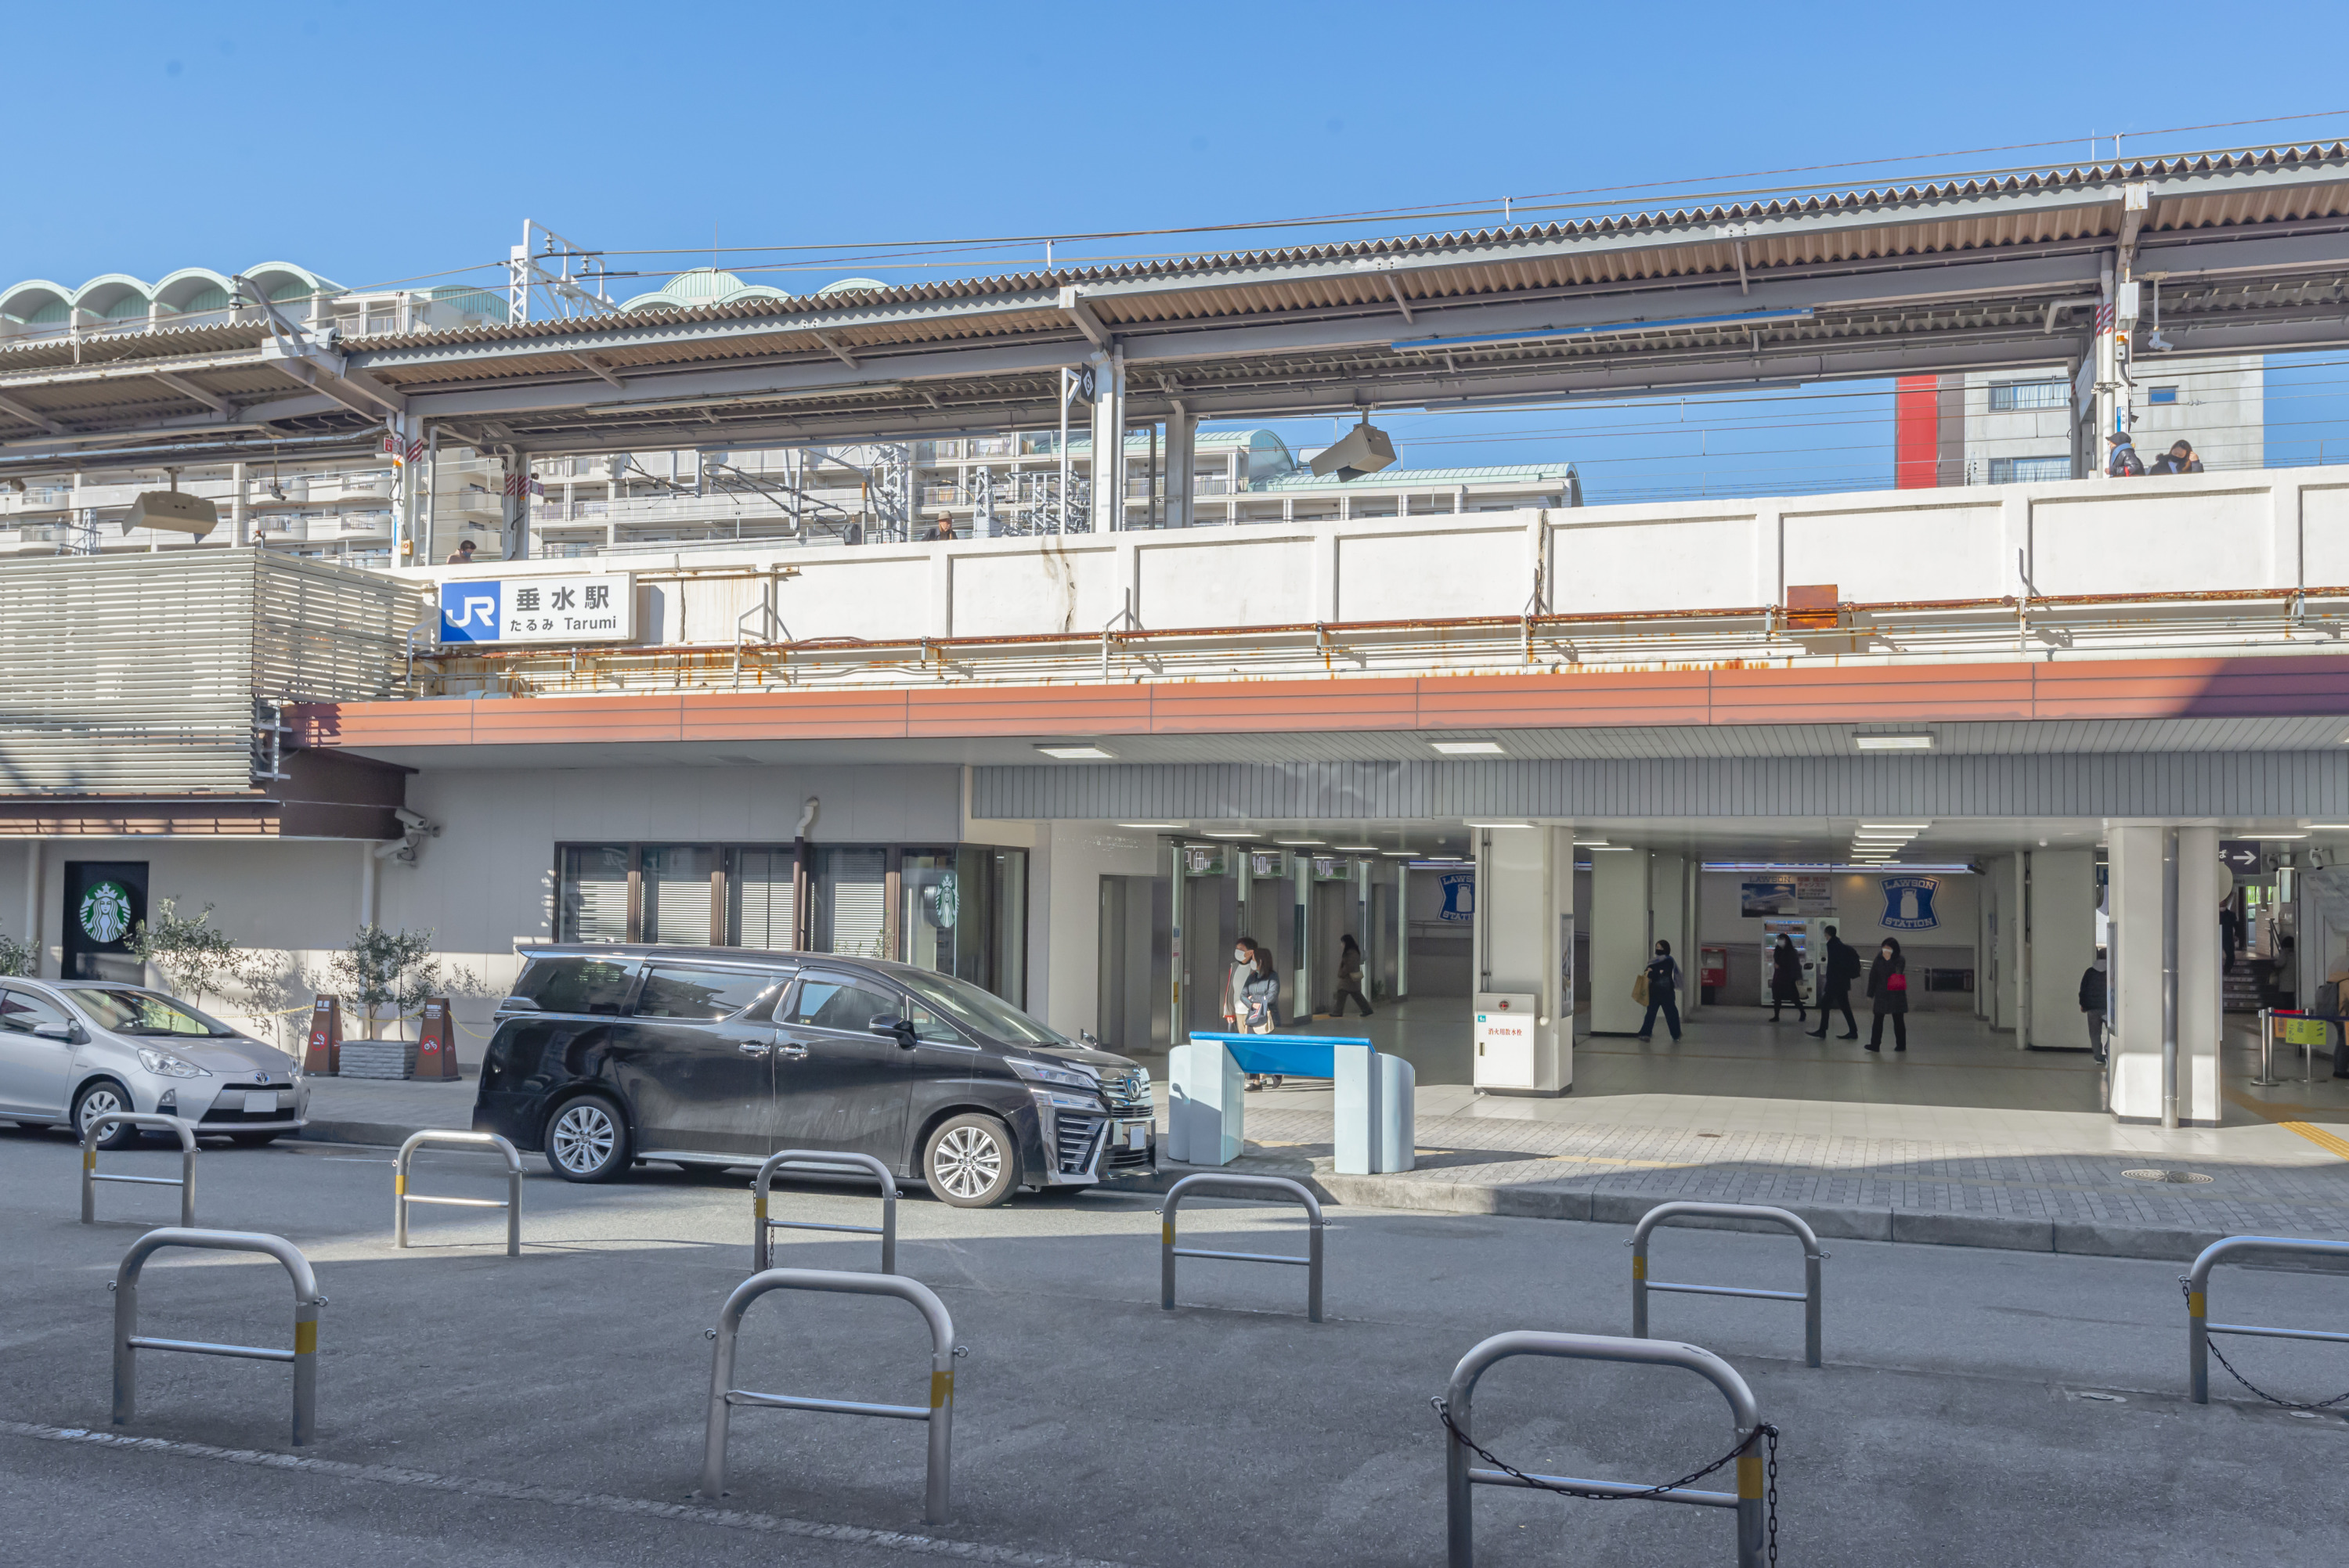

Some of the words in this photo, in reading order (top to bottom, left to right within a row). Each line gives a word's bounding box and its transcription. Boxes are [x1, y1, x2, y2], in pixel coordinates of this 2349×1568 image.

[516, 585, 609, 612] 垂水駅
[446, 596, 495, 628] JR
[511, 618, 554, 632] たるみ
[564, 615, 616, 630] Tarumi
[1884, 879, 1935, 890] LAWSON
[1885, 917, 1934, 928] STATION
